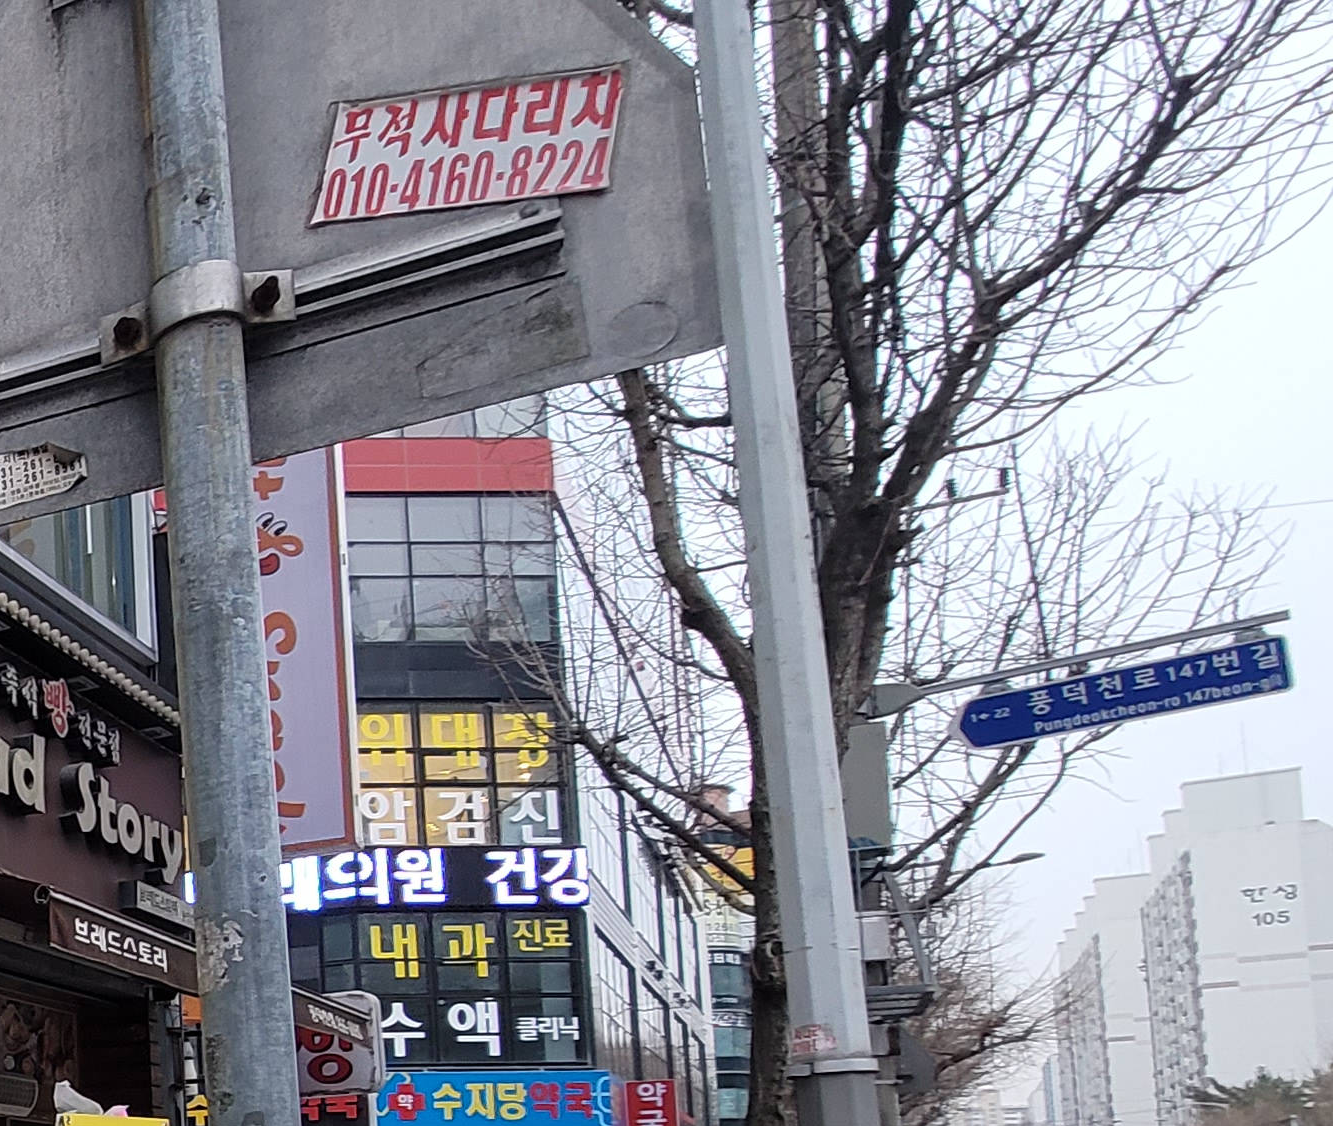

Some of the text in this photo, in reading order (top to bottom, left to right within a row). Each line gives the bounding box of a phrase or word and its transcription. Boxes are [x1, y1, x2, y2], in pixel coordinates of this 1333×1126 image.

[69, 762, 183, 885] Story
[1252, 910, 1291, 926] 105
[74, 917, 168, 974] 브레드스토리
[516, 1015, 580, 1041] 클리닉
[431, 1082, 595, 1121] 수지당약국
